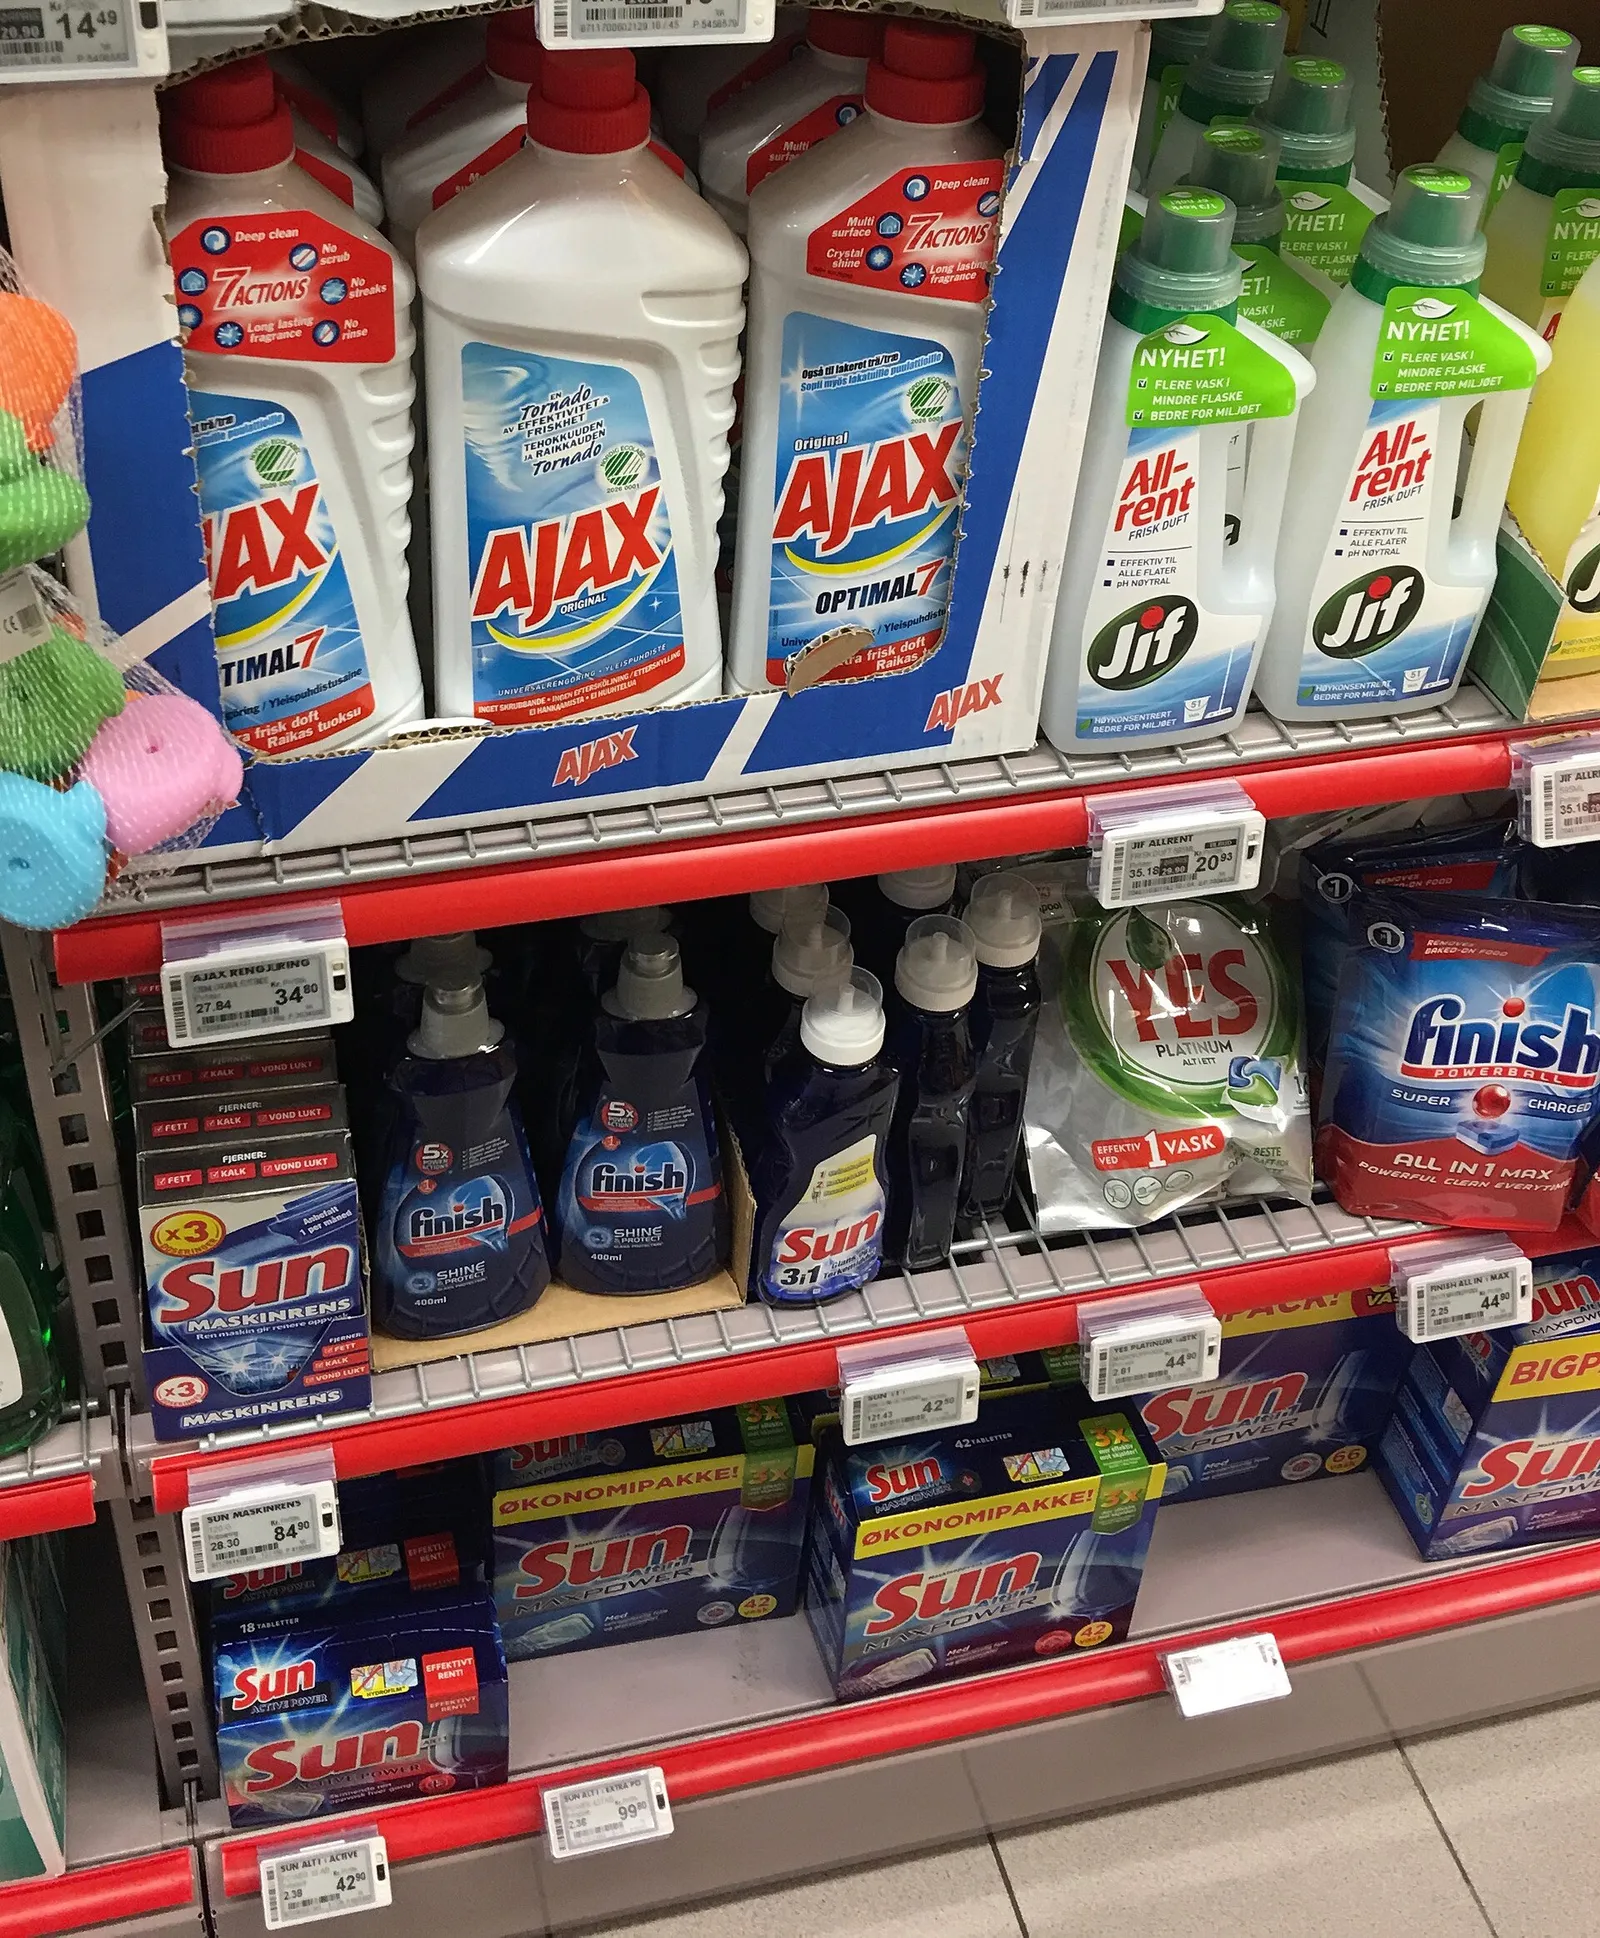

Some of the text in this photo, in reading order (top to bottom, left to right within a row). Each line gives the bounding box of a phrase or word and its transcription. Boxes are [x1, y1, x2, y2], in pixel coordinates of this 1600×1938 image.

[933, 176, 990, 190] Deep clean
[847, 216, 874, 227] Multi
[235, 228, 299, 243] Deep clean
[831, 227, 871, 238] surface
[826, 248, 864, 262] Crystal
[832, 258, 861, 269] shine
[929, 264, 954, 276] Long
[930, 271, 977, 285] fragrance
[247, 322, 274, 333] Long
[250, 327, 302, 344] fragrance
[1386, 320, 1470, 342] NYHET!
[1140, 347, 1226, 368] NYHET!
[1401, 351, 1467, 362] FLERE VASK
[802, 364, 824, 380] Også
[1397, 364, 1486, 378] MINDRE FLASKE
[1155, 378, 1224, 390] FLERE VASK
[1394, 376, 1503, 393] BEDRE FOR MILJØET
[520, 385, 592, 420] Tornado
[1152, 391, 1243, 405] MINDRE FLASKE
[517, 399, 601, 432] EFFEKTIVITET
[1150, 403, 1261, 421] BEDRE FOR MILJØET
[523, 420, 604, 451] TEHOKKUUDEN
[526, 413, 586, 438] FRISKHET
[536, 428, 606, 458] RAIKKAUDEN
[793, 431, 849, 452] Original
[531, 443, 602, 476] Tornado
[1350, 449, 1432, 502] rent
[773, 420, 964, 554] AJAX
[1114, 477, 1195, 532] rent
[1363, 484, 1424, 511] FRISK DUFT
[1128, 513, 1189, 541] FRISK DUFT
[1353, 528, 1395, 536] EFFEKTIV
[1350, 537, 1407, 546] ALLE FLATER
[473, 486, 661, 630] AJAX
[1120, 558, 1162, 566] EFFEKTIV
[1118, 566, 1176, 577] ALLE FLATER
[560, 594, 607, 614] ORIGINAL
[1321, 576, 1415, 648] Jif
[866, 636, 926, 662] frisk doft
[1097, 605, 1188, 679] Jif
[876, 651, 918, 671] Raikas
[923, 672, 1004, 732] AJAX
[1313, 691, 1342, 701] BEDRE
[254, 710, 320, 741] frisk doft
[267, 706, 362, 749] Raikas tuoksu
[1092, 723, 1120, 734] BEDRE
[551, 724, 639, 787] AJAX
[1131, 835, 1194, 849] JIF ALLRENT
[192, 971, 227, 982] AJAX
[1106, 949, 1259, 1042] YES
[196, 1000, 231, 1014] 27.84
[1404, 995, 1600, 1075] finish
[1156, 1039, 1233, 1059] PLATINUM
[1434, 1065, 1563, 1085] POWERBALL
[1391, 1089, 1451, 1106] SUPER
[1528, 1099, 1593, 1114] CHARGED
[165, 1108, 322, 1131] FETT KALK VOND LUKT
[1097, 1142, 1140, 1155] EFFEKTIV
[1165, 1133, 1216, 1157] VASK
[222, 1151, 267, 1164] FJERNER:
[1099, 1156, 1118, 1165] VED
[1393, 1153, 1554, 1180] ALL IN MAX
[167, 1157, 328, 1184] FETT KALK VOND LUKT
[592, 1163, 685, 1193] finish
[1358, 1160, 1490, 1190] POWERFUL CLEAN
[302, 1206, 339, 1226] Anbefalt
[307, 1209, 353, 1234] per måned
[411, 1197, 503, 1237] finish
[613, 1225, 663, 1238] SHINE
[778, 1211, 880, 1264] Sun
[437, 1261, 486, 1280] SHINE
[160, 1247, 350, 1323] Sun
[188, 1298, 351, 1332] MASKINRENS
[1431, 1307, 1449, 1317] 2.25
[316, 1367, 365, 1381] VOND LUKT
[183, 1391, 341, 1427] MASKINRENS
[1141, 1372, 1308, 1443] Sun
[955, 1432, 1013, 1449] 42 TABLETTER
[1333, 1449, 1361, 1463] 66
[866, 1457, 943, 1501] Sun
[499, 1466, 738, 1514] ØKONOMIPAKKE!
[207, 1501, 301, 1523] SUN MASKINRENS
[861, 1489, 1093, 1546] ØKONOMIPAKKE!
[211, 1538, 240, 1551] 28.30
[515, 1525, 692, 1598] Sun
[745, 1597, 770, 1608] 42
[864, 1552, 1043, 1636] Sun
[240, 1617, 299, 1633] 18 TABLETTER
[1080, 1624, 1105, 1637] 42
[426, 1657, 473, 1672] EFFEKTIVT
[232, 1660, 316, 1710] Sun
[438, 1670, 464, 1680] RENT!
[251, 1693, 328, 1715] ACTIVE POWER
[429, 1696, 476, 1709] EFFEKTIVT
[246, 1721, 422, 1793] Sun
[281, 1863, 299, 1872] SUN
